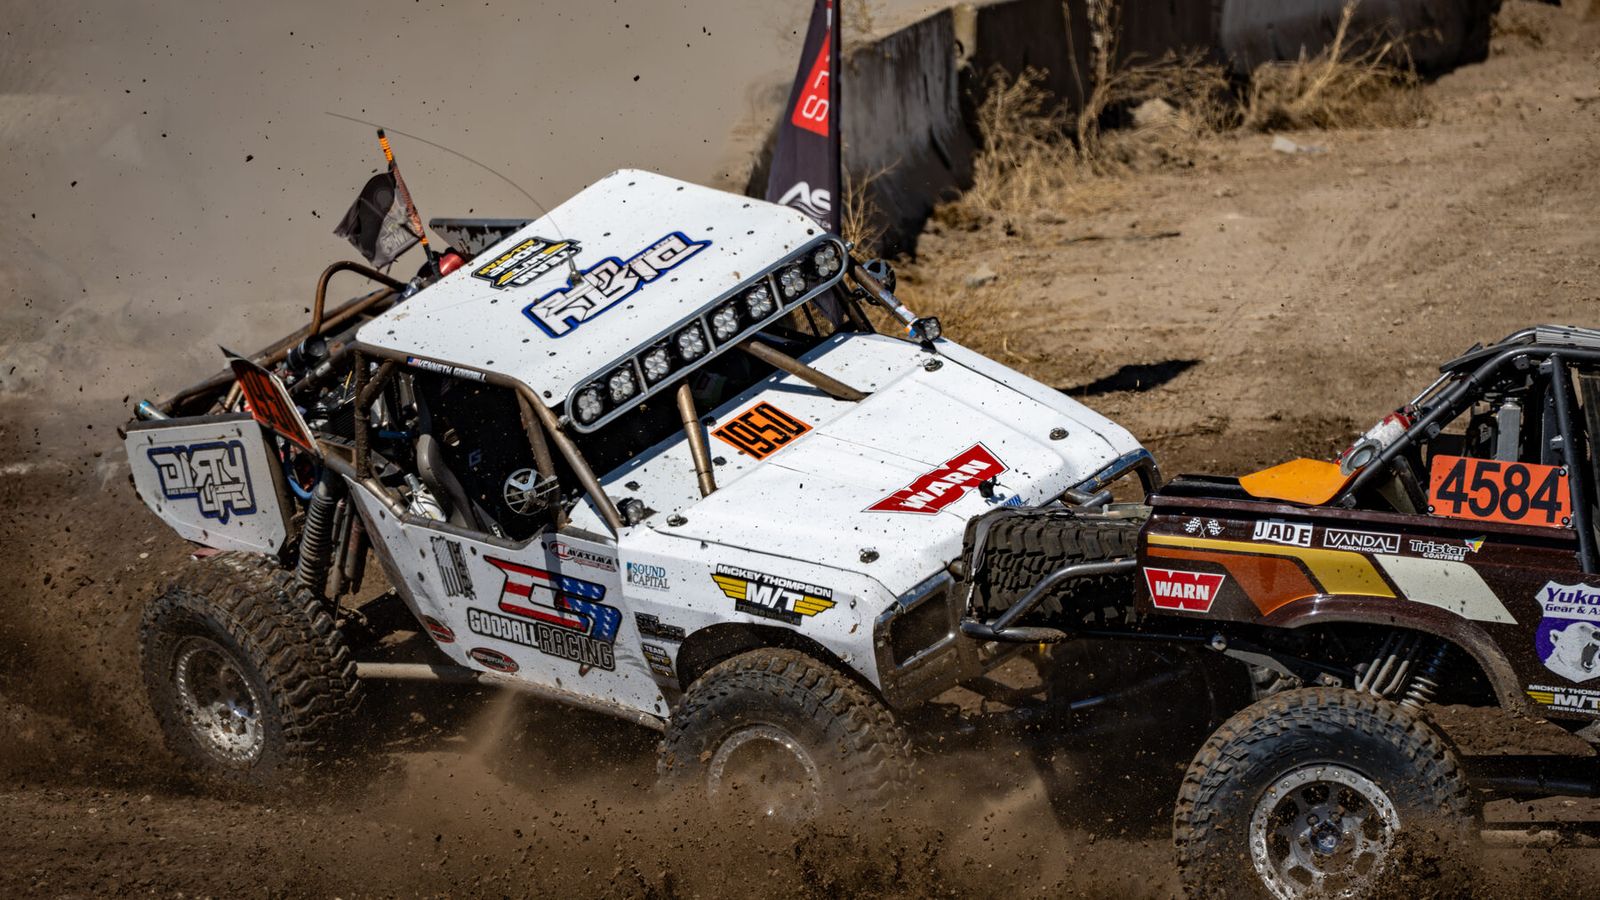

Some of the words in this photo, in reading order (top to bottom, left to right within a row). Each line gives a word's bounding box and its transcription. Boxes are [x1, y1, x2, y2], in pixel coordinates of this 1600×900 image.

[715, 402, 807, 460] 1950
[151, 446, 242, 488] DIRTY
[899, 459, 992, 510] WARN
[1436, 458, 1563, 523] 4584
[1255, 521, 1311, 545] JADE
[1328, 531, 1395, 550] VANDAL
[567, 549, 613, 564] MAXIMA
[1410, 540, 1468, 556] Tristar
[632, 562, 666, 578] SOUND
[632, 573, 671, 590] CAPITAL
[762, 572, 833, 598] THOMPSON
[1155, 580, 1210, 600] WARN
[746, 582, 804, 612] M/T
[1547, 587, 1600, 605] Yuko
[1545, 604, 1575, 613] Gear
[1577, 606, 1585, 614] &
[1588, 607, 1600, 615] A
[469, 608, 540, 648] GOODALL
[539, 624, 615, 671] RACING
[1528, 684, 1566, 692] MICKEY
[1554, 694, 1600, 709] M/T
